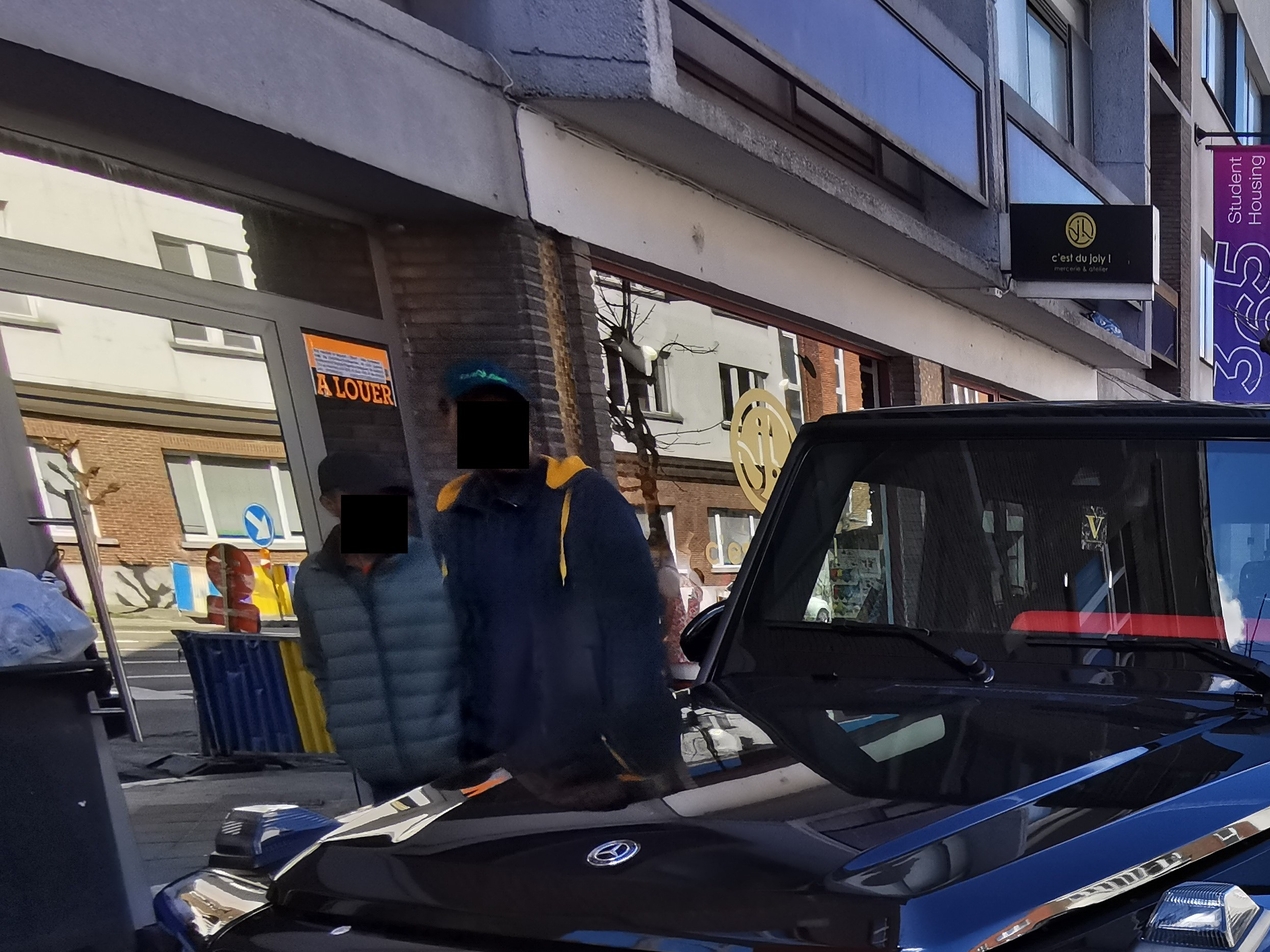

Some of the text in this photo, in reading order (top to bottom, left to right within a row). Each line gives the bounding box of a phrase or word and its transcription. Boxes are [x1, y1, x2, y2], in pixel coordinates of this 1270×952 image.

[1227, 155, 1243, 225] Student
[1248, 154, 1266, 225] Housing
[1051, 253, 1073, 263] c'est
[1075, 253, 1087, 263] du
[1089, 253, 1106, 265] joly
[332, 375, 395, 406] LOUER
